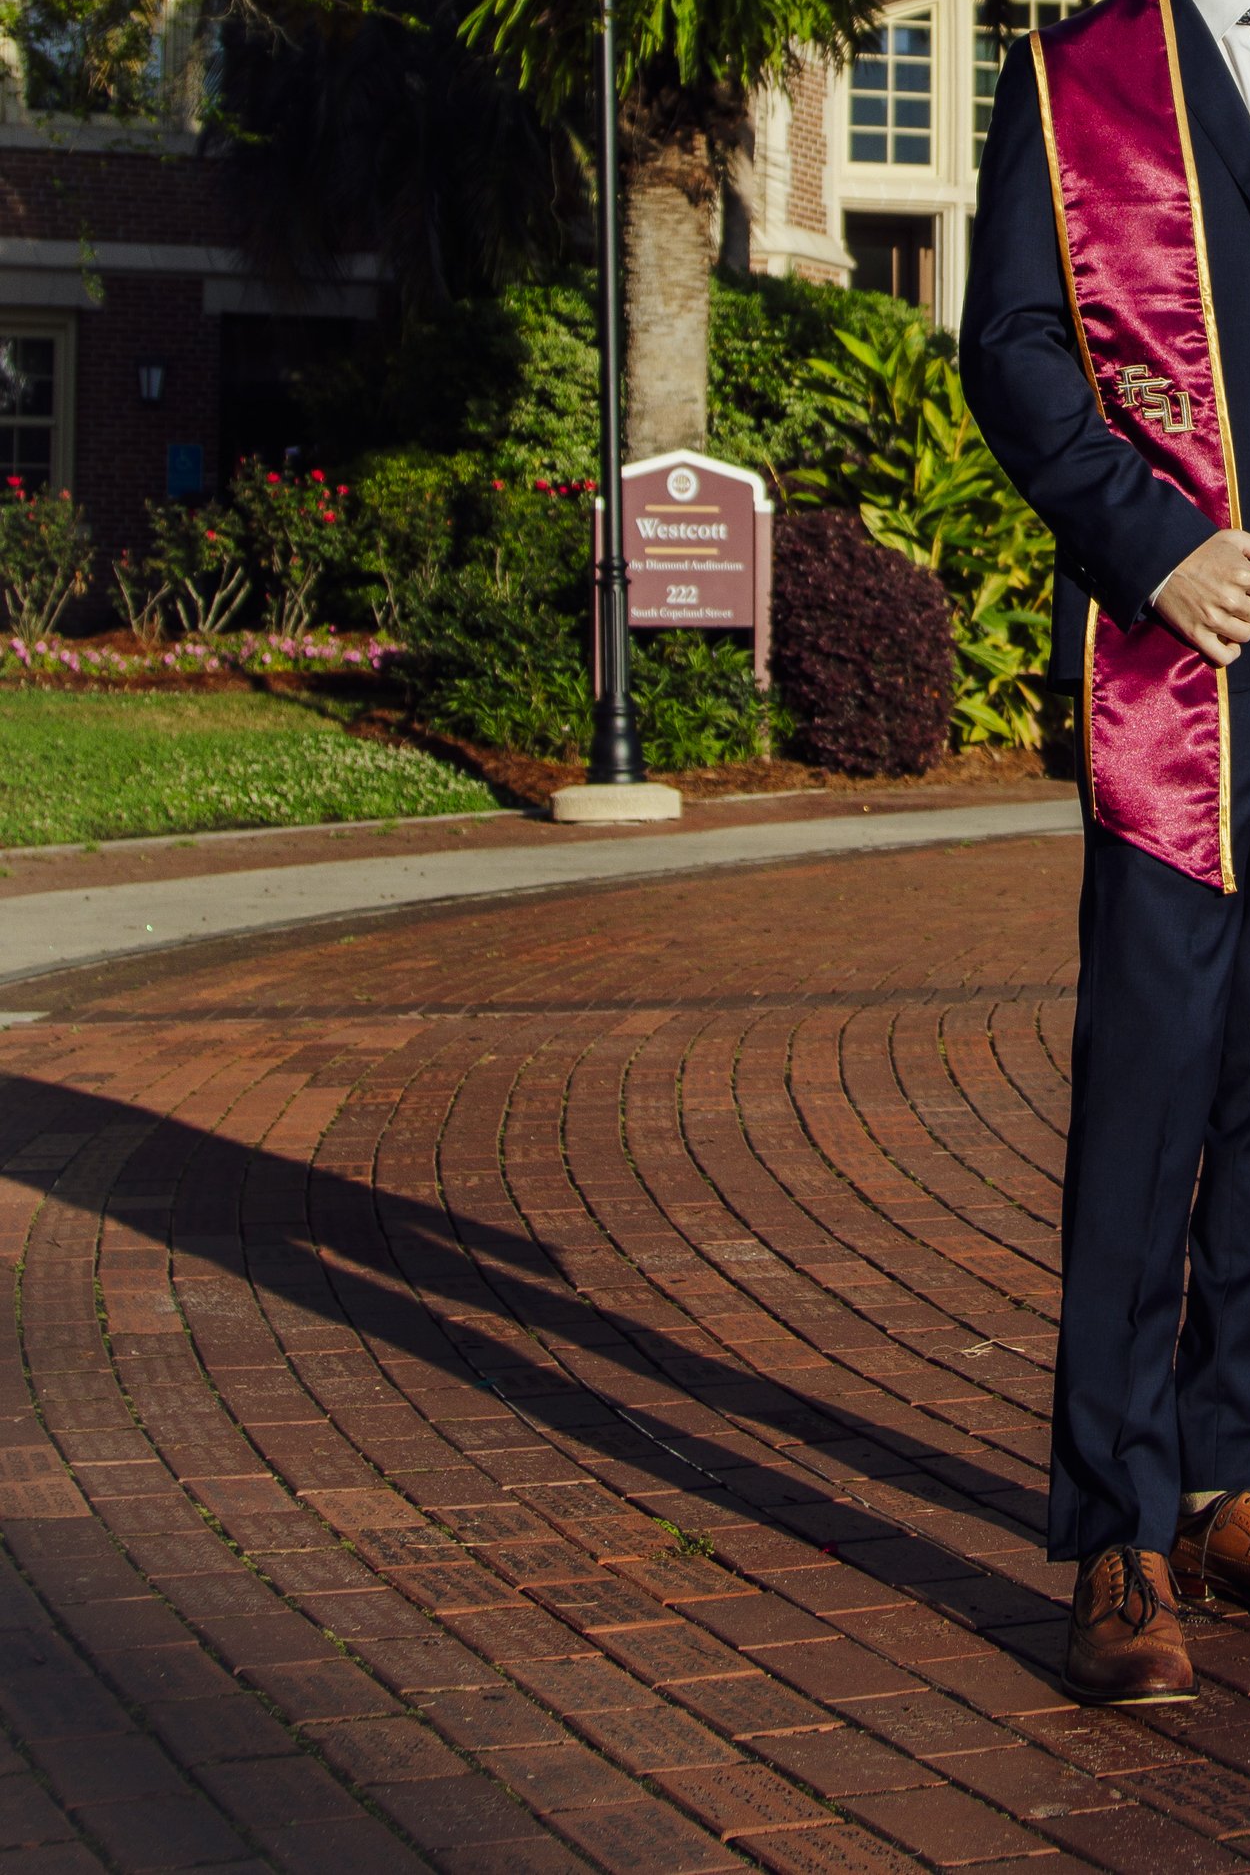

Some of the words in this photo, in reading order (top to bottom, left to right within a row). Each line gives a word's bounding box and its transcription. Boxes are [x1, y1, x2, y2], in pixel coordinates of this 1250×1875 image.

[1116, 364, 1196, 433] FSU
[635, 518, 728, 540] Westcott
[646, 558, 688, 571] Diamond
[691, 559, 744, 571] Auditorium
[666, 585, 698, 604] 222
[705, 607, 733, 618] Street
